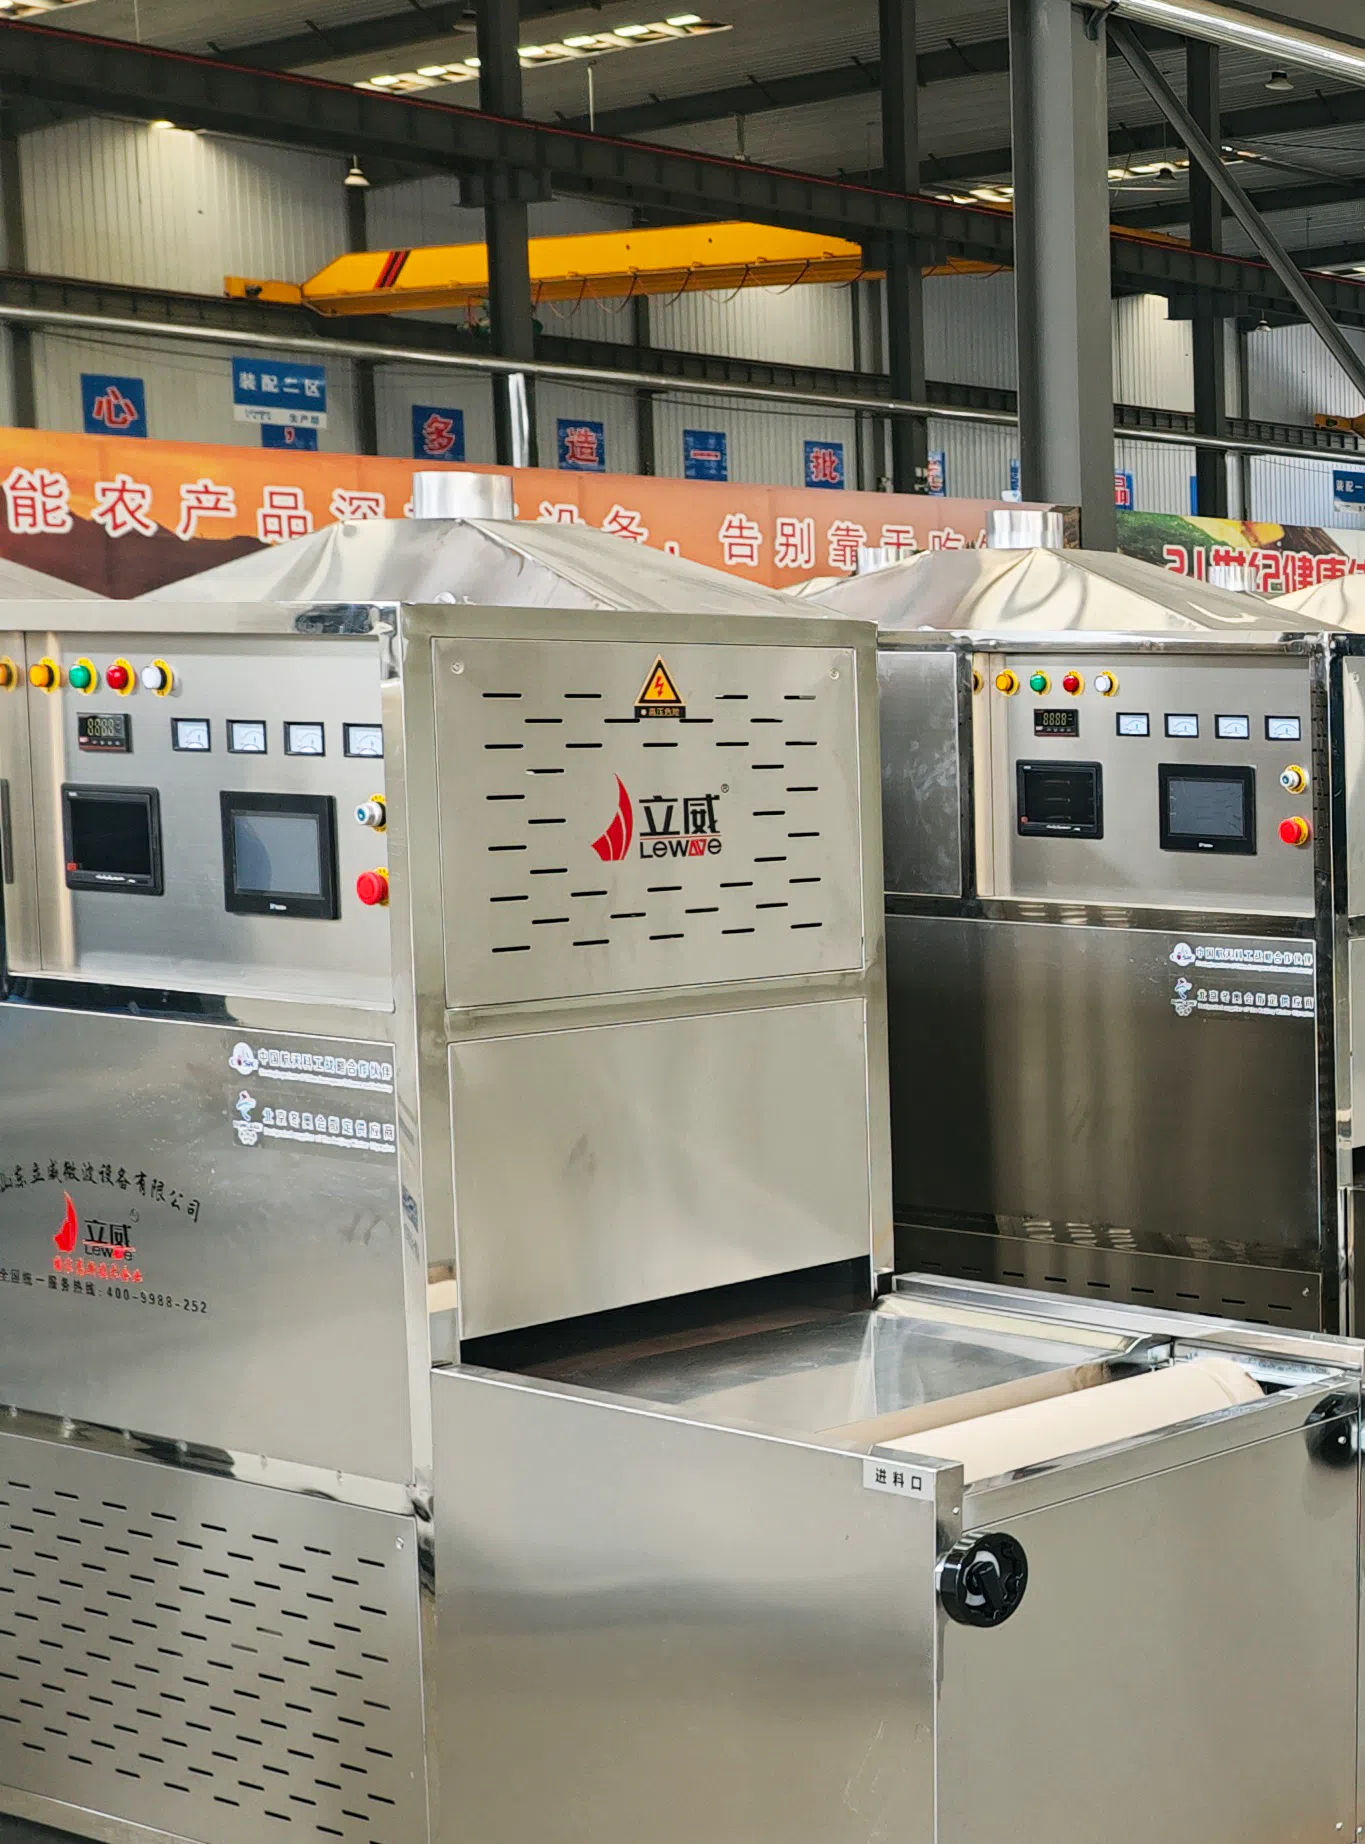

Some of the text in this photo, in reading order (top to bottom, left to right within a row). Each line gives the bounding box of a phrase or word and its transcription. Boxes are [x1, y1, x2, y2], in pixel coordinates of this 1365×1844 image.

[238, 371, 321, 398] 装配二区
[92, 385, 138, 429] 心
[423, 413, 456, 455] 多
[565, 426, 599, 464] 造
[810, 448, 839, 483] 批
[639, 793, 721, 836] 立威
[84, 1219, 132, 1248] 立威
[875, 1467, 922, 1492] 进料口
